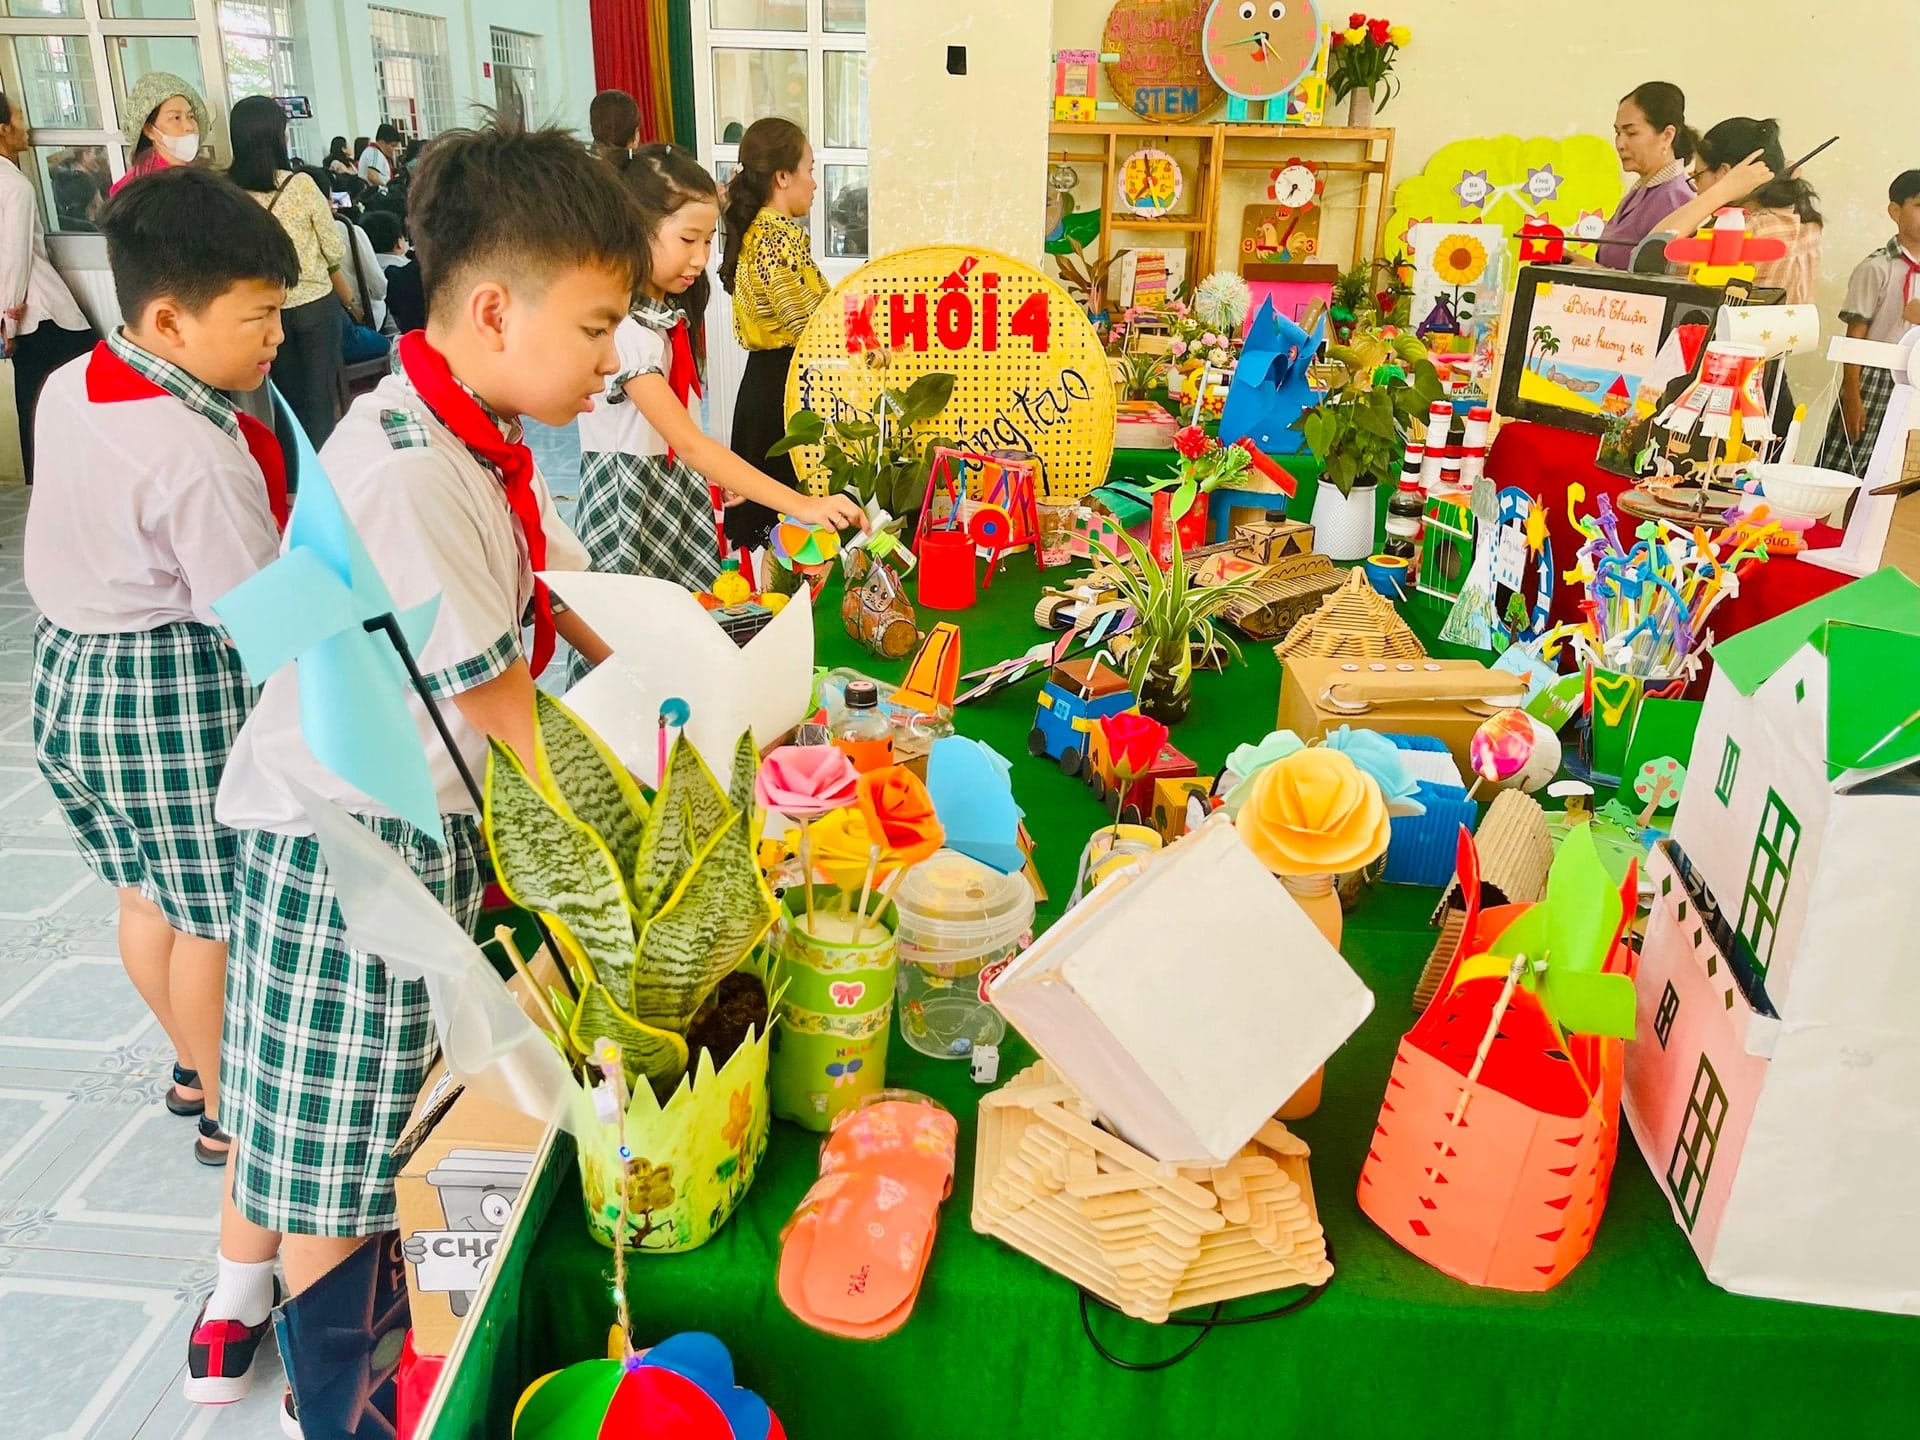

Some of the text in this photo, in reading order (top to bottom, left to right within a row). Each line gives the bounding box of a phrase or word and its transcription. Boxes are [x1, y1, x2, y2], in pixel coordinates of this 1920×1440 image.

[1134, 86, 1199, 115] STEM
[1244, 239, 1254, 252] 9
[1305, 239, 1314, 252] 3
[1011, 292, 1050, 353] 4
[1571, 334, 1592, 352] quê
[1011, 369, 1094, 435] tạo
